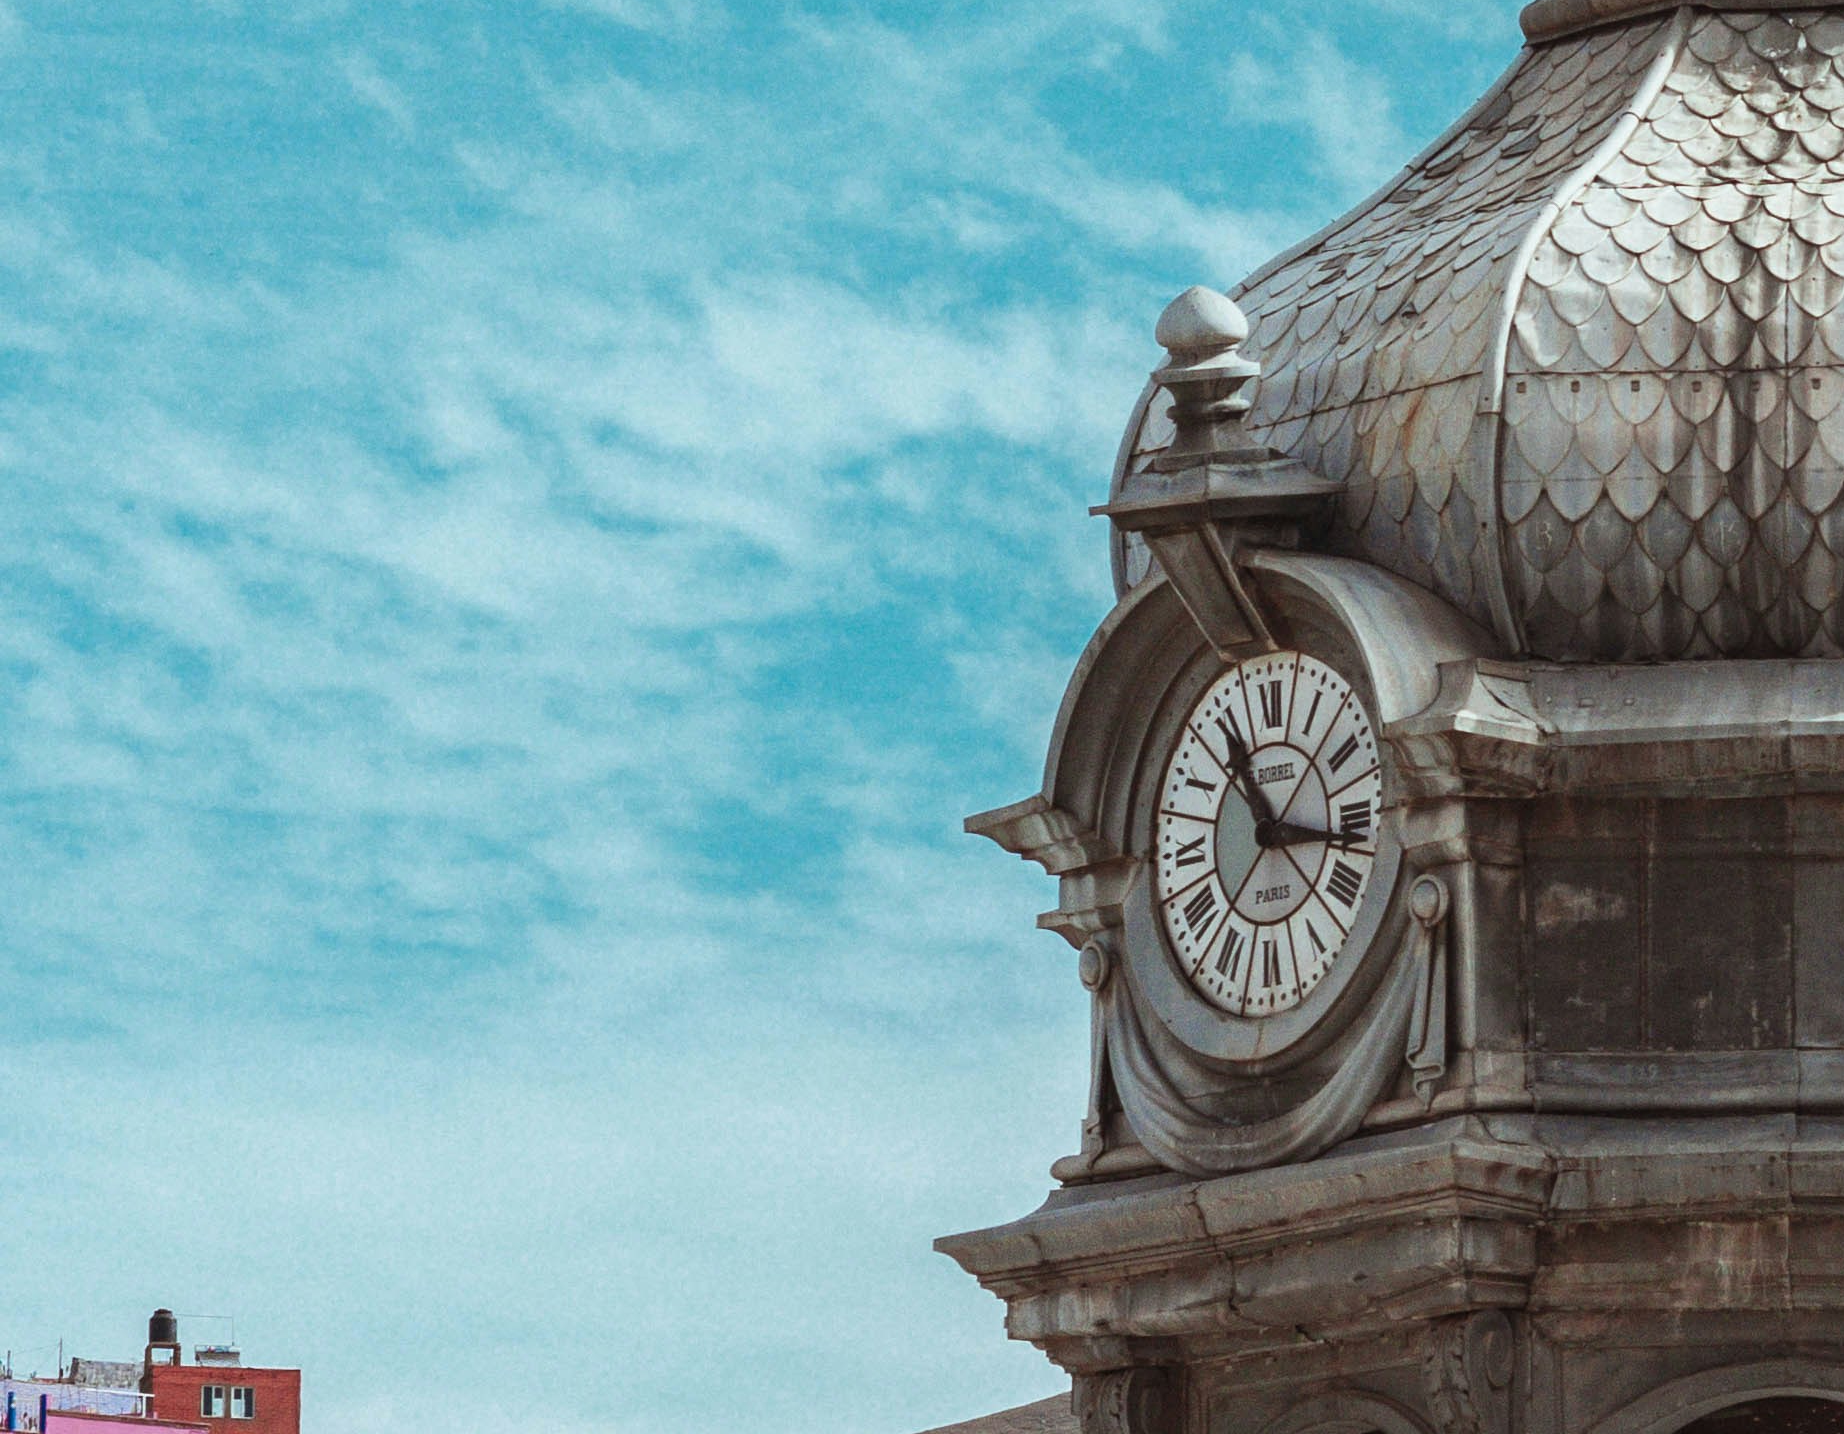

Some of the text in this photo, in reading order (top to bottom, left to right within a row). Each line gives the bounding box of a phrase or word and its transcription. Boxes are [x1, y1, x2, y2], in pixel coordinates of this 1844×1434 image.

[1257, 680, 1284, 732] XII
[1301, 689, 1324, 737] I
[1327, 732, 1360, 775] II
[1185, 767, 1217, 804] X
[1176, 833, 1207, 868] IX
[1255, 884, 1290, 904] PARIS
[1326, 859, 1364, 909] IIII
[1183, 882, 1220, 944] VIII
[1214, 925, 1246, 983] VII
[1261, 938, 1283, 988] VI
[1305, 917, 1327, 962] V
